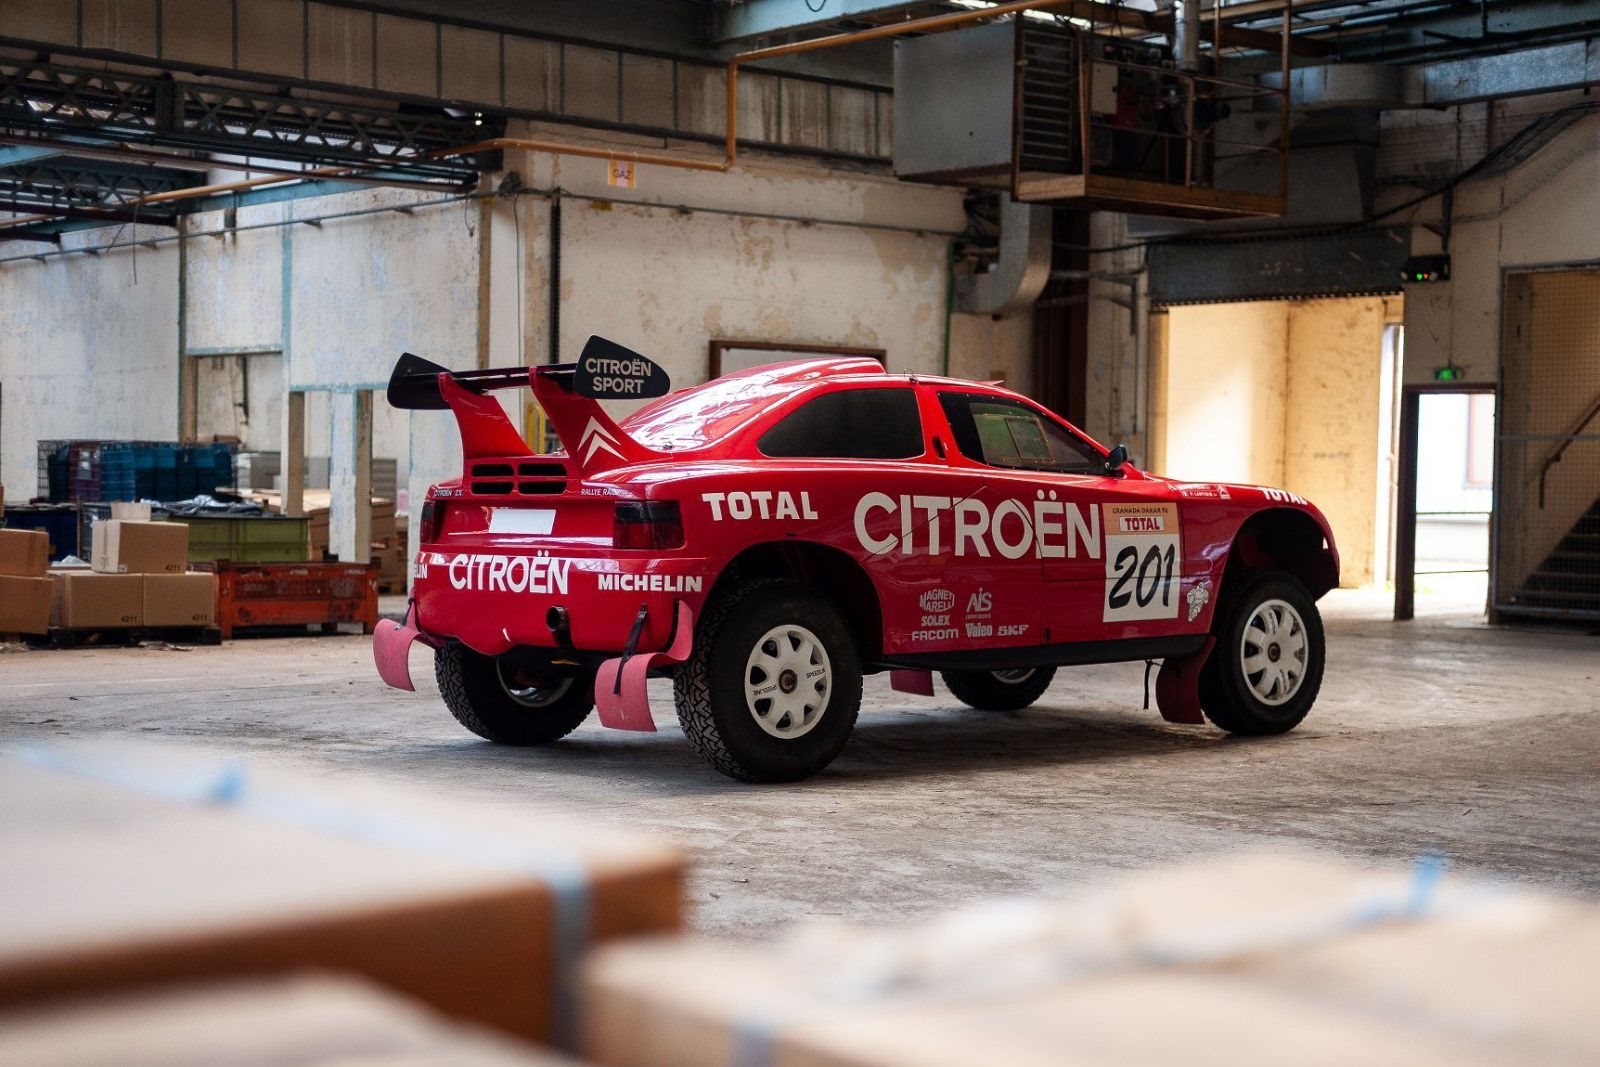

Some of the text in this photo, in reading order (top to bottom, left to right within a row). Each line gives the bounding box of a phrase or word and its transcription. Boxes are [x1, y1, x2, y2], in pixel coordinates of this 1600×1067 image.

[585, 358, 652, 377] CITROËN
[592, 376, 644, 394] SPORT
[1257, 486, 1308, 505] TOTAL
[701, 491, 819, 521] TOTAL
[853, 489, 1101, 559] CITROËN
[1125, 517, 1160, 531] TOTAL
[449, 550, 571, 595] CITROËN
[1108, 543, 1176, 610] 201
[598, 574, 702, 593] MICHELIN
[921, 615, 951, 627] SOLEX
[965, 622, 993, 638] Valeo
[997, 624, 1029, 636] SKF
